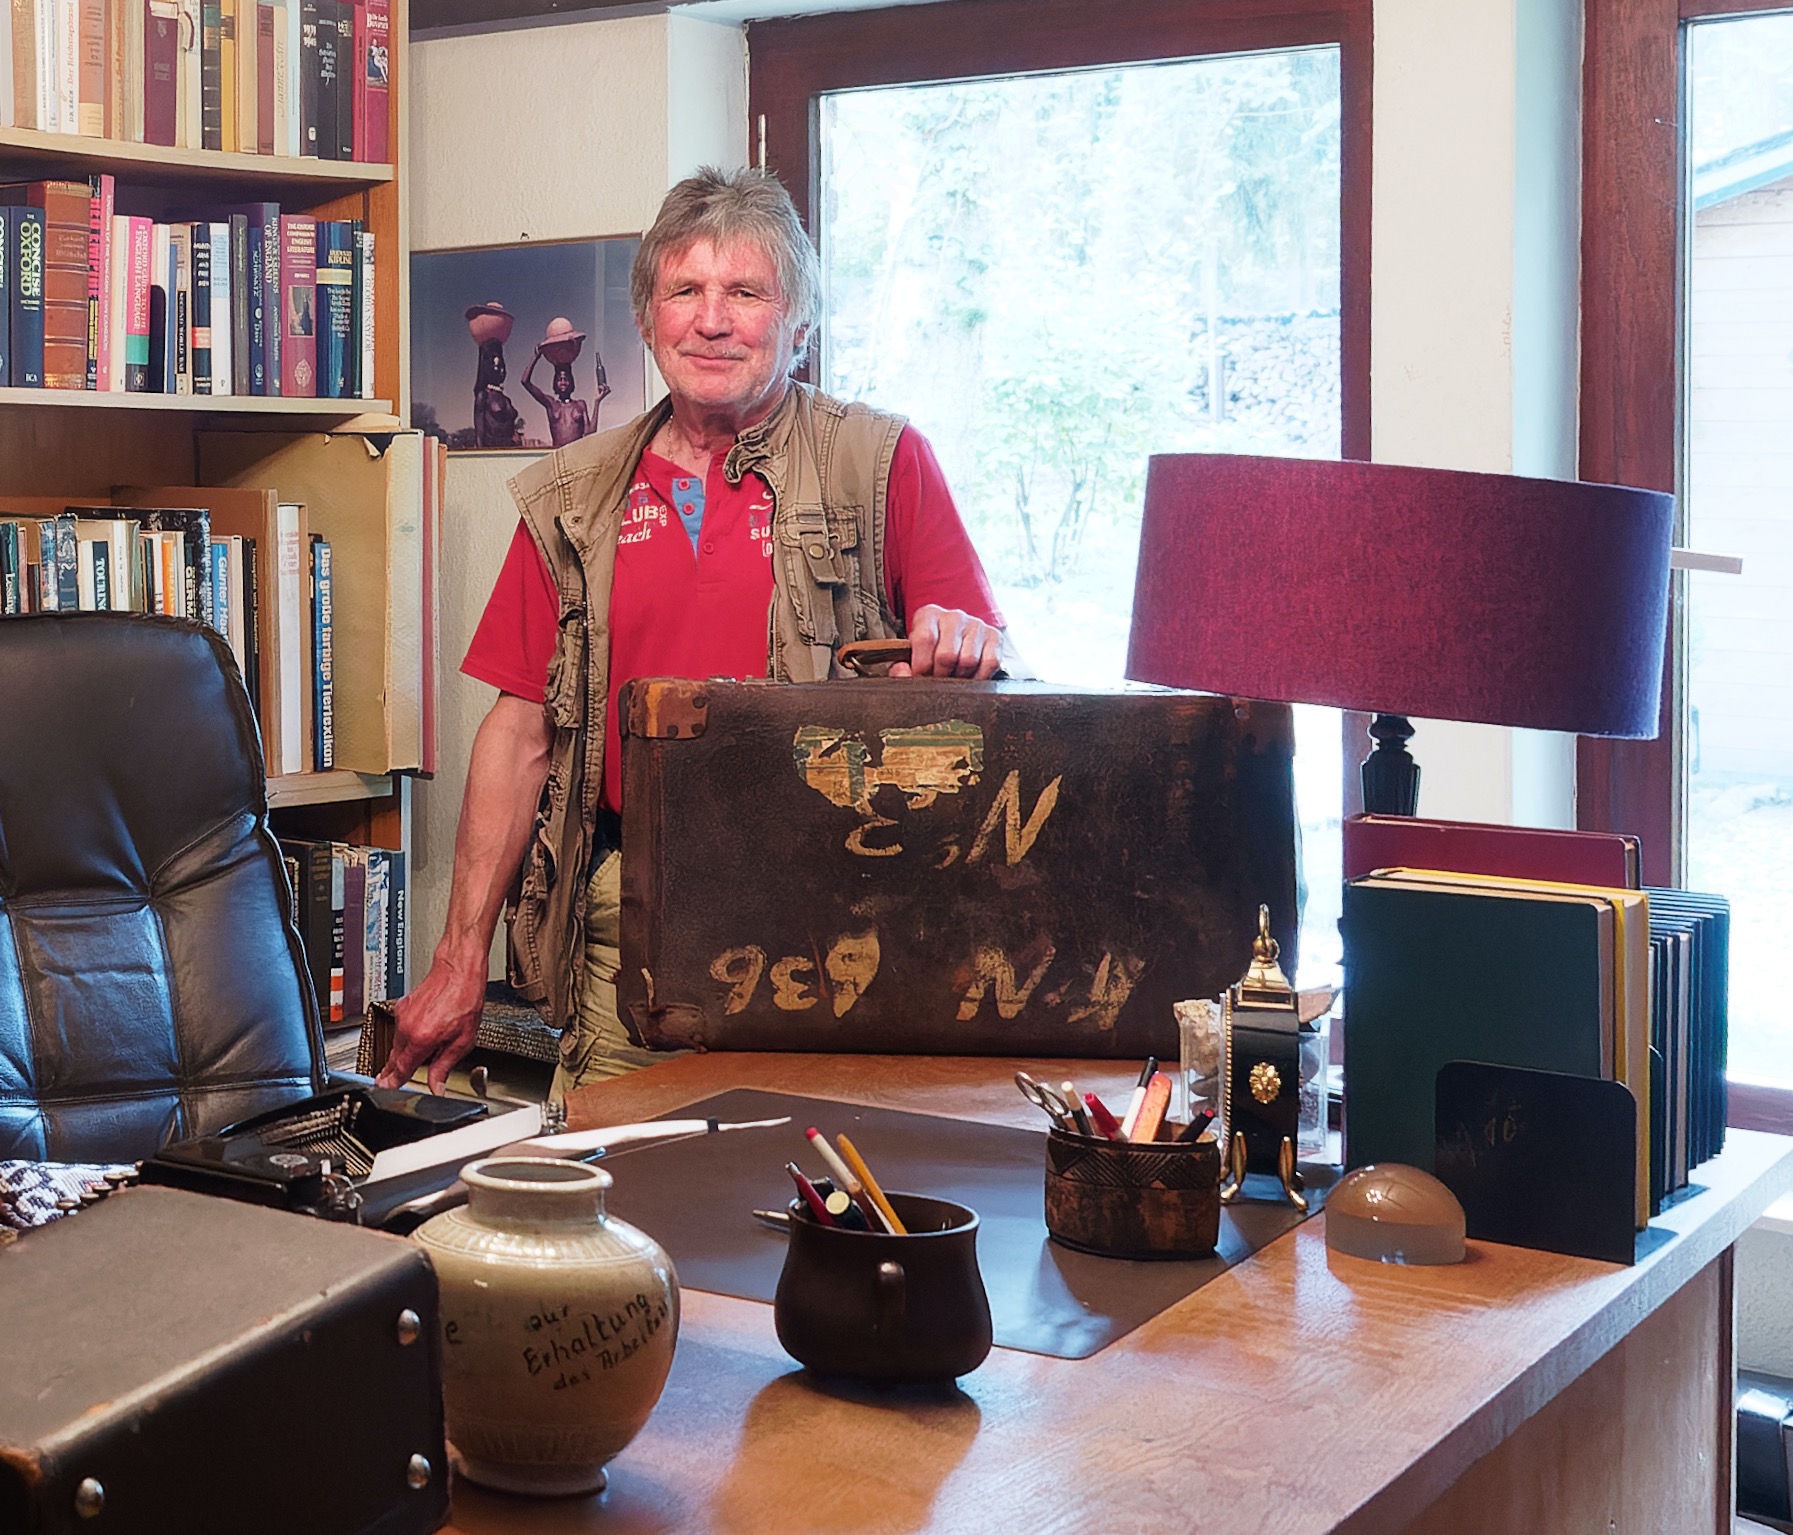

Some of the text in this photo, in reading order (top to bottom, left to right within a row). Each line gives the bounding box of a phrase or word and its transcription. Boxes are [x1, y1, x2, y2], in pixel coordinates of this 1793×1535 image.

[20, 221, 32, 296] OXFORD
[31, 222, 41, 297] CONCISE
[134, 230, 142, 275] ENGLISH
[264, 224, 272, 284] OF ENGLAND
[5, 573, 16, 615] Lessing
[319, 548, 334, 768] Das große farbige Tierlexikon
[396, 922, 404, 974] England
[522, 1292, 651, 1377] Erhaltung
